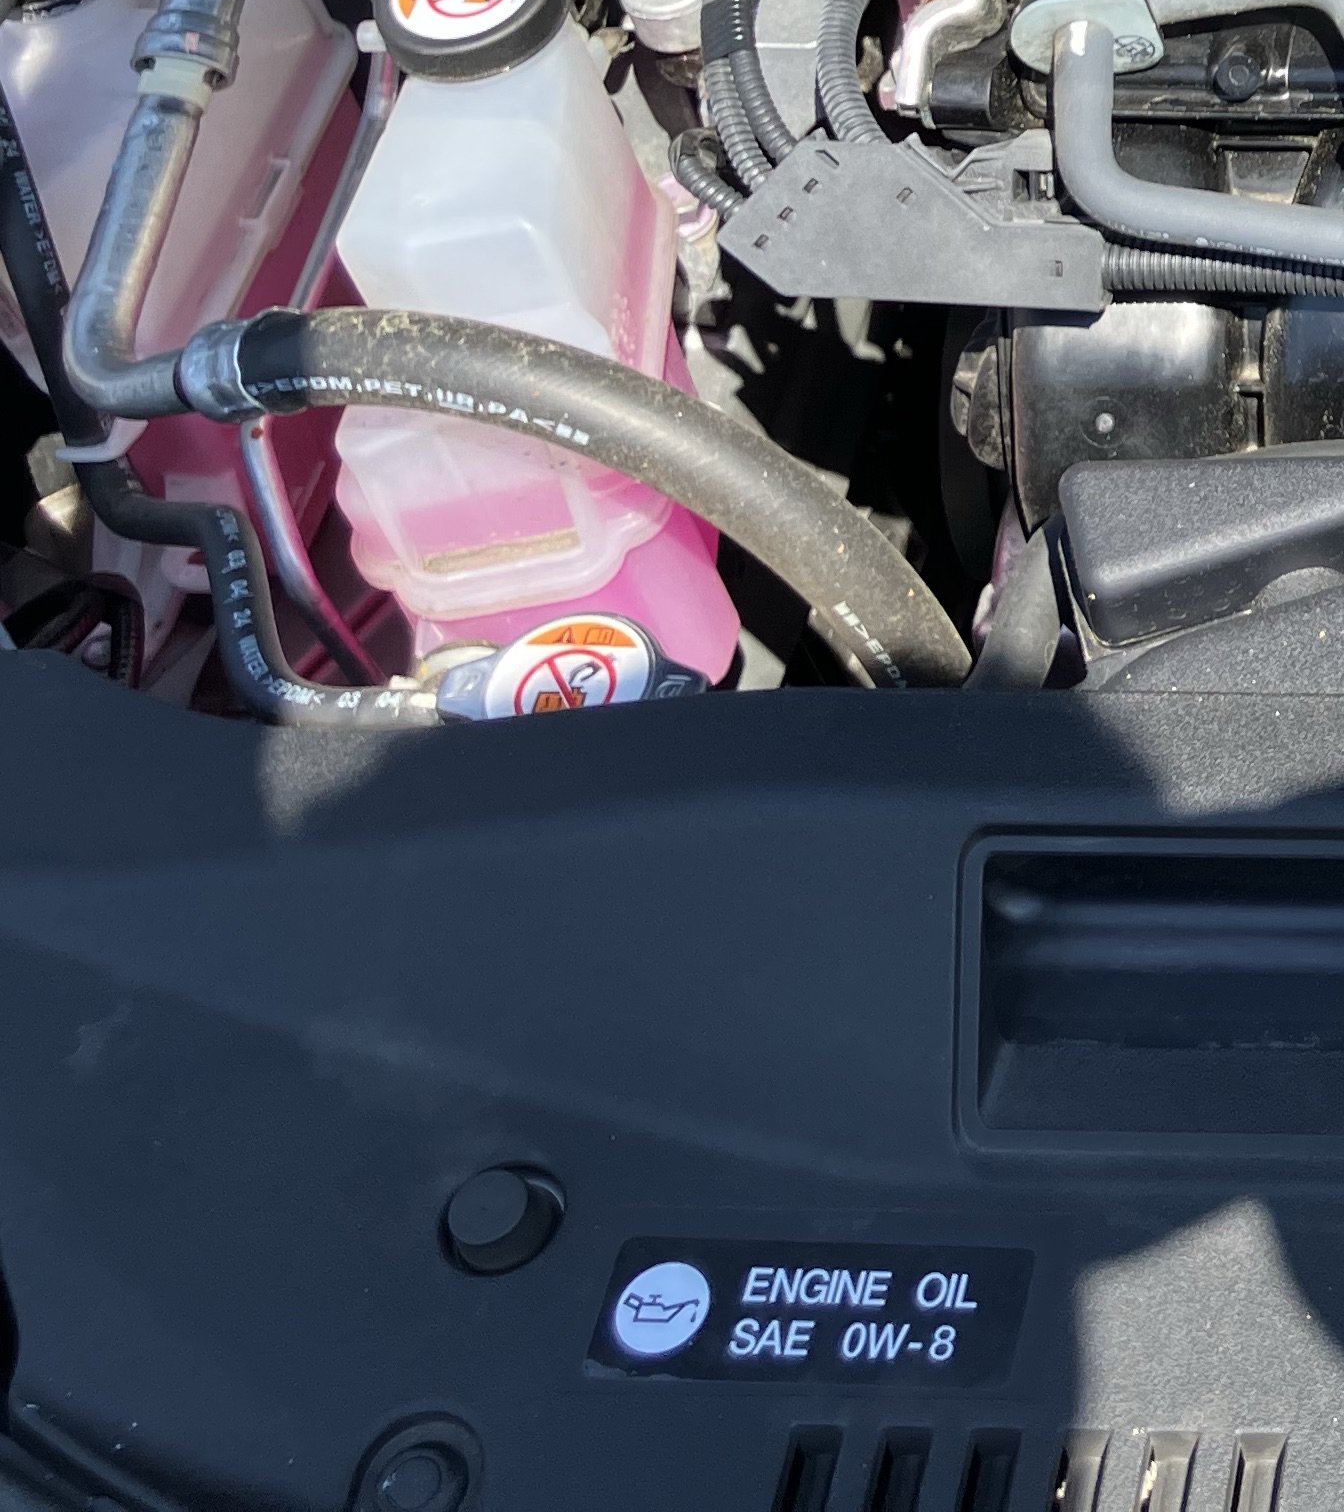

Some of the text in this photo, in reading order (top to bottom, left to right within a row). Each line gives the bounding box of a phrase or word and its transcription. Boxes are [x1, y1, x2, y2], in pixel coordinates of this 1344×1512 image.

[741, 1266, 979, 1309] ENGINE OIL
[728, 1317, 957, 1362] SAE 0W-8
